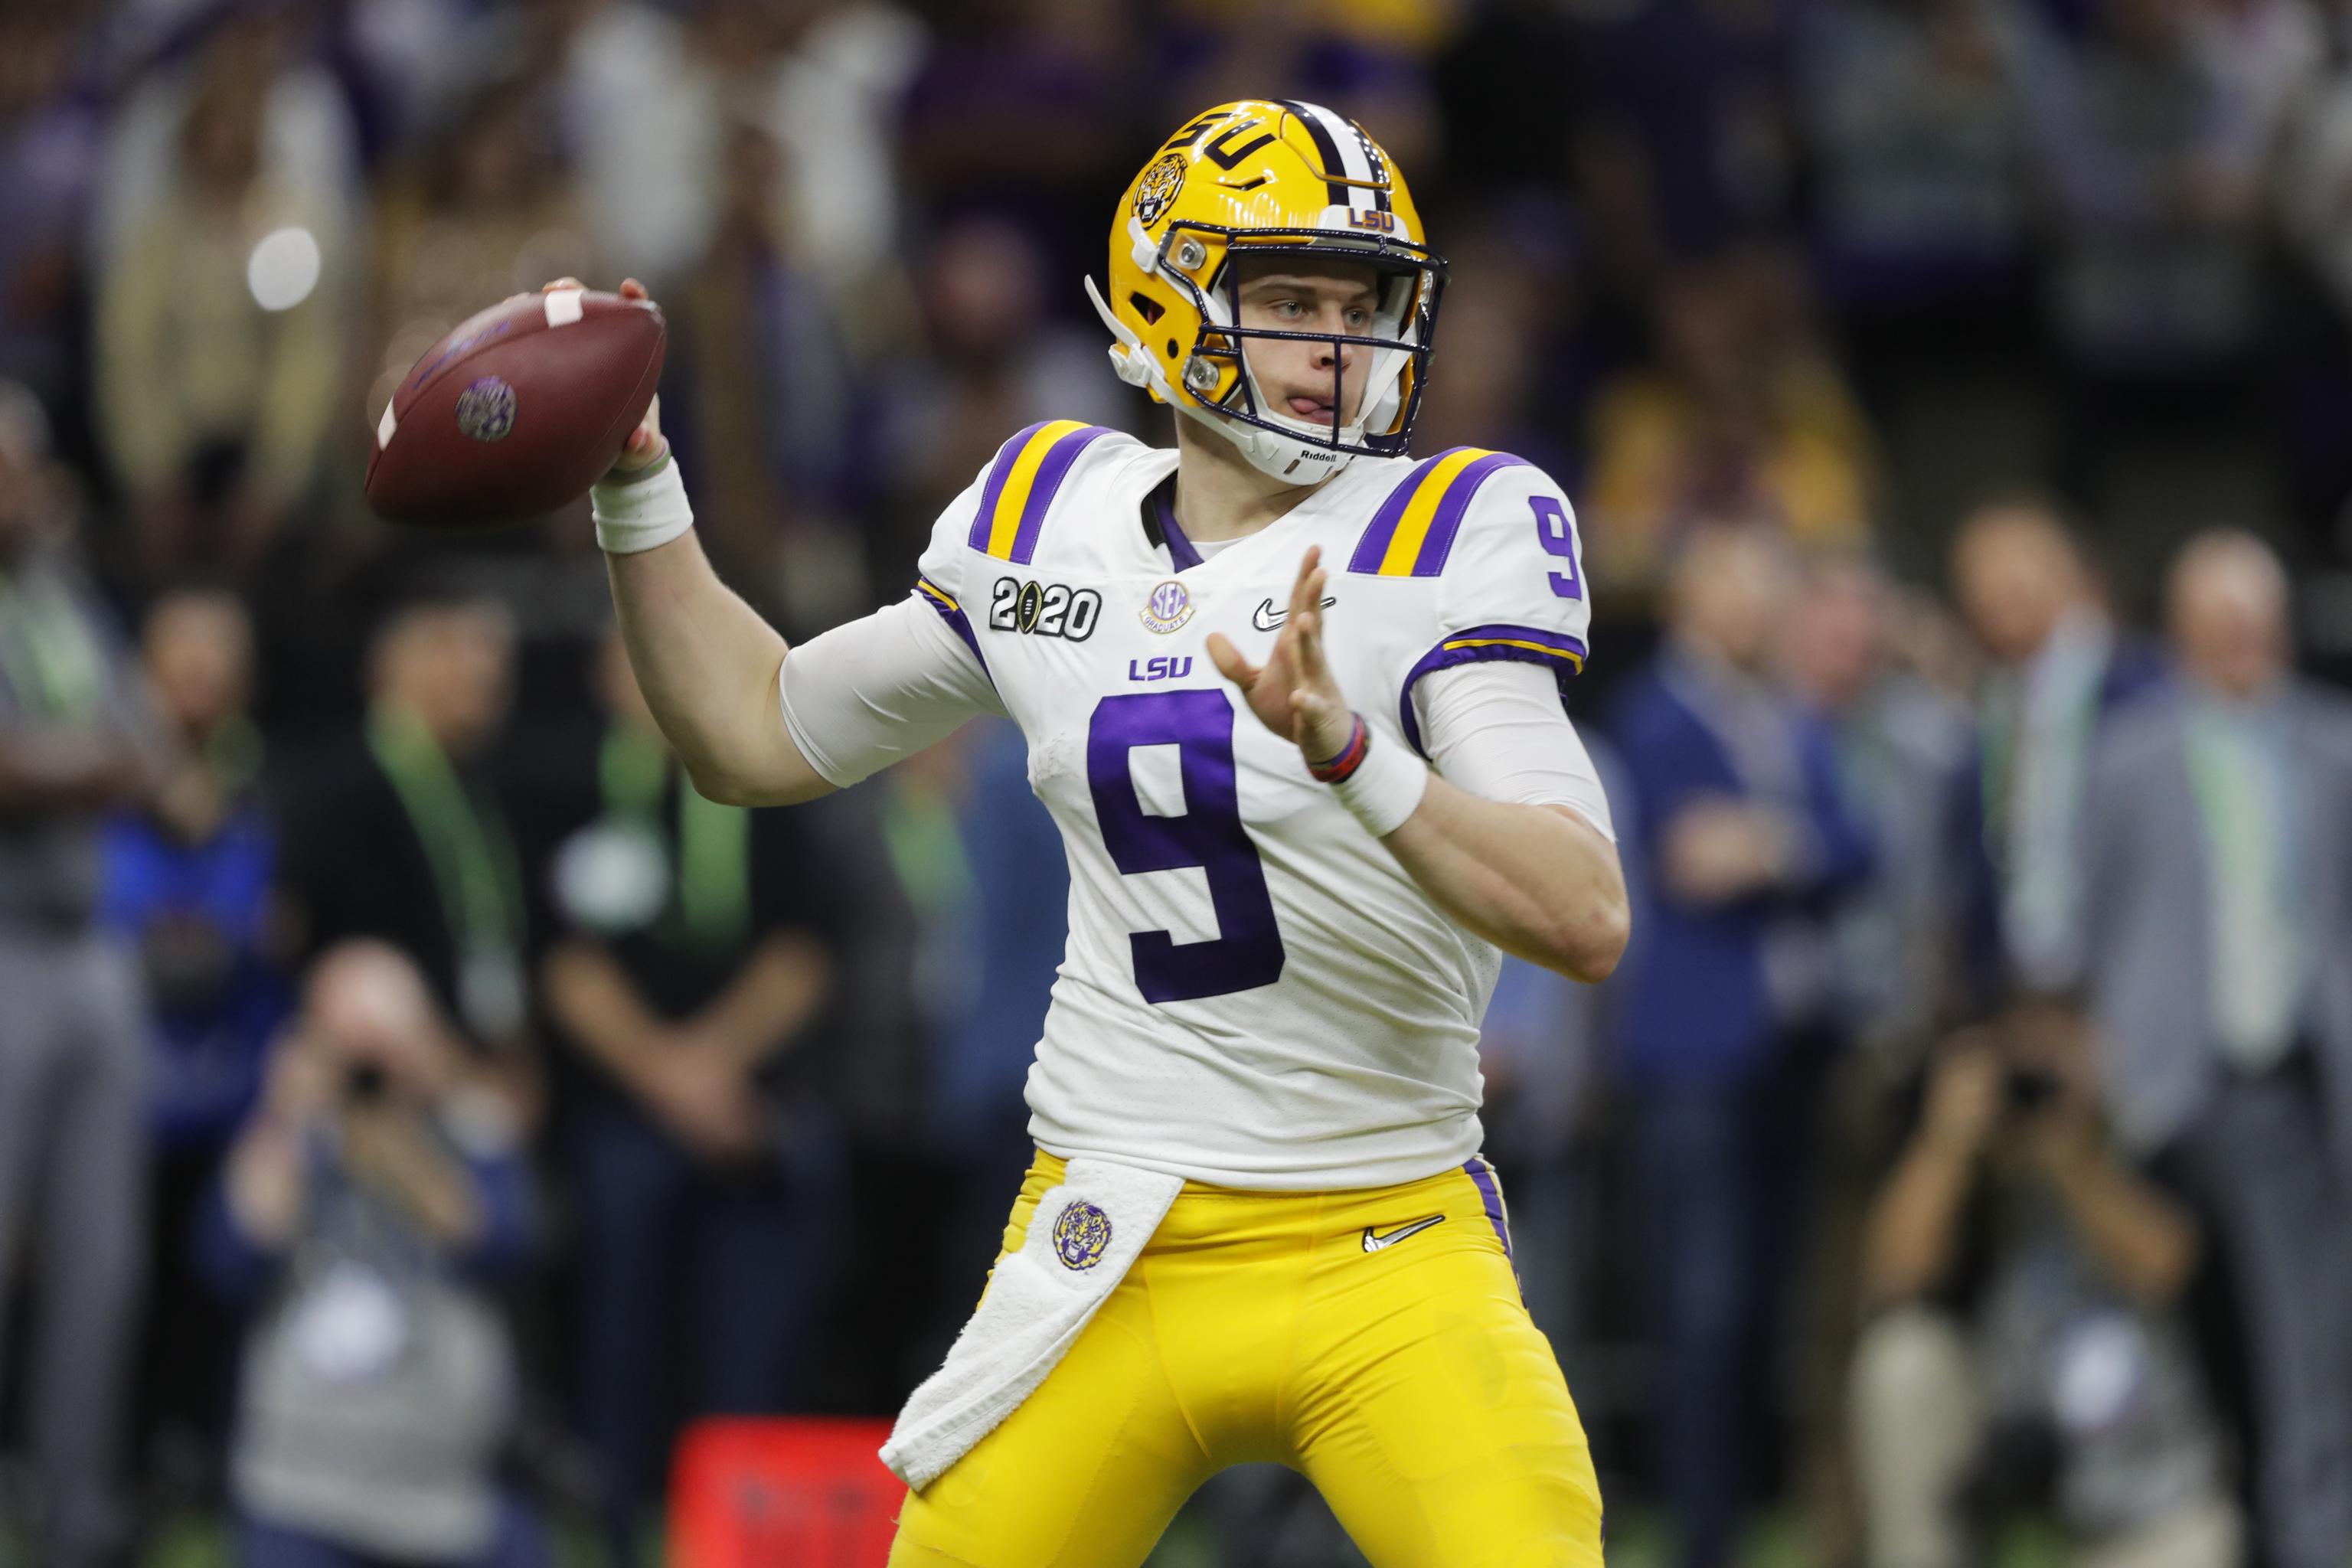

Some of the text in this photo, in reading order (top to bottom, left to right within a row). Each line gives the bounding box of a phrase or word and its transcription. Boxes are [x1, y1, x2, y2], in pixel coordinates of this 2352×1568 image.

[1163, 113, 1277, 171] SU
[1348, 207, 1394, 233] LSU
[1301, 450, 1337, 462] Riddell
[1528, 495, 1582, 602] 9
[990, 576, 1102, 642] 2020
[1150, 583, 1187, 619] SEC
[1145, 616, 1185, 632] GRADUATE
[1129, 656, 1193, 681] LSU
[1087, 688, 1285, 1004] 9
